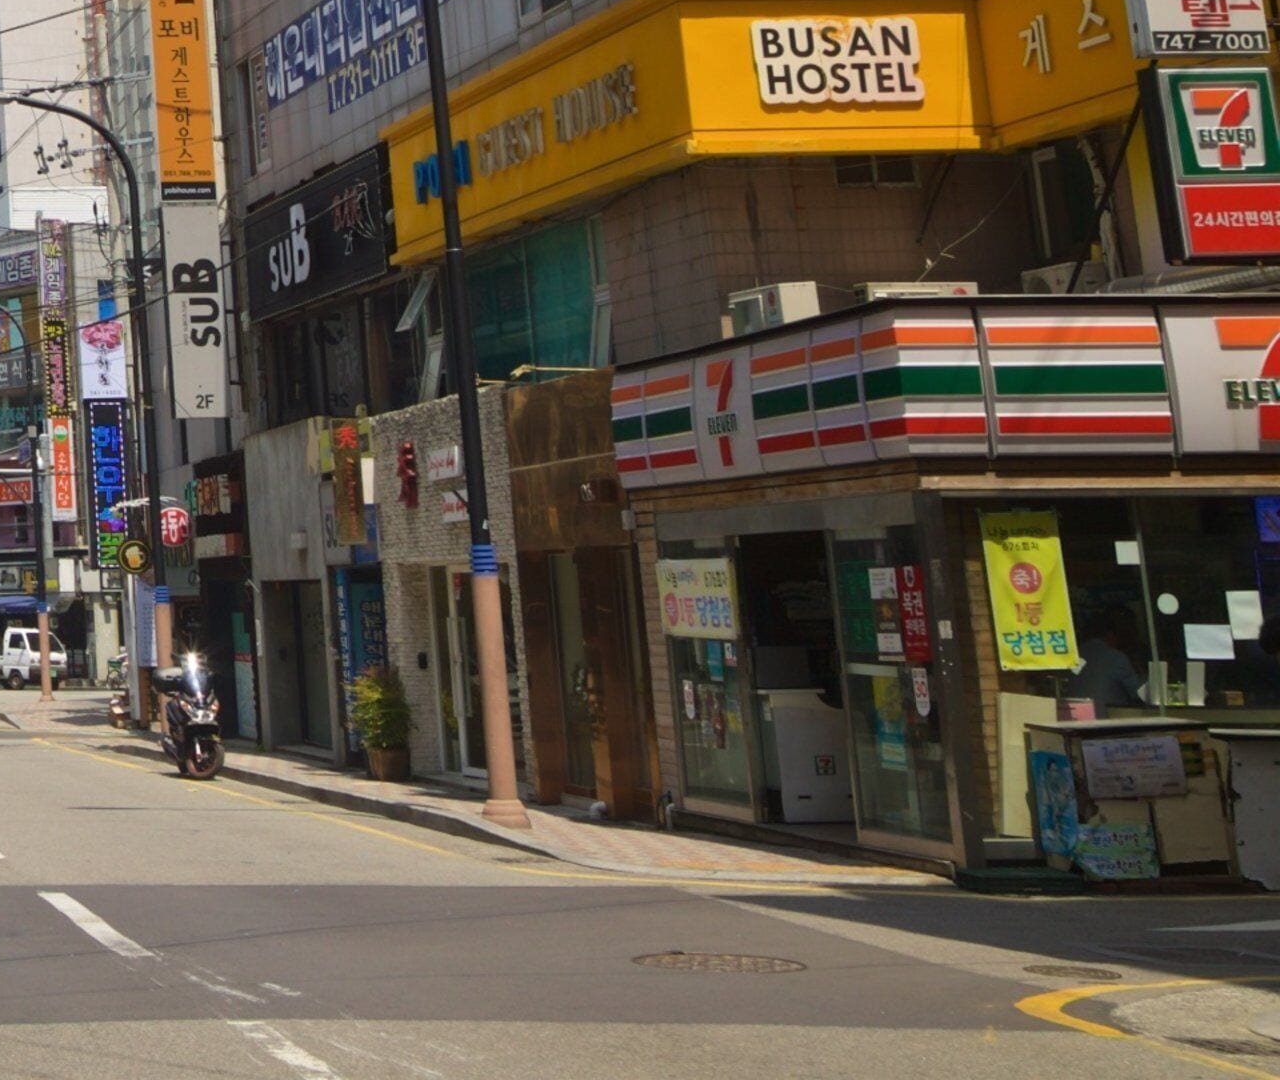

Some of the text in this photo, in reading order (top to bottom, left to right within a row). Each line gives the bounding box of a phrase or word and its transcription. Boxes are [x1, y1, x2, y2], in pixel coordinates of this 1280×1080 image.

[157, 18, 200, 41] 포비
[405, 22, 424, 71] 3F
[759, 23, 911, 60] BUSAN
[1156, 33, 1266, 52] 747-7001
[765, 59, 918, 98] HOSTEL
[171, 46, 195, 164] 게스트하우스
[476, 107, 546, 177] GUEST
[552, 63, 640, 144] HOUSE
[269, 203, 311, 293] SUB
[172, 257, 222, 348] SUB
[196, 394, 215, 409] 2F
[93, 425, 124, 504] 한우
[1014, 602, 1044, 627] 1등
[1002, 629, 1070, 657] 당첨점
